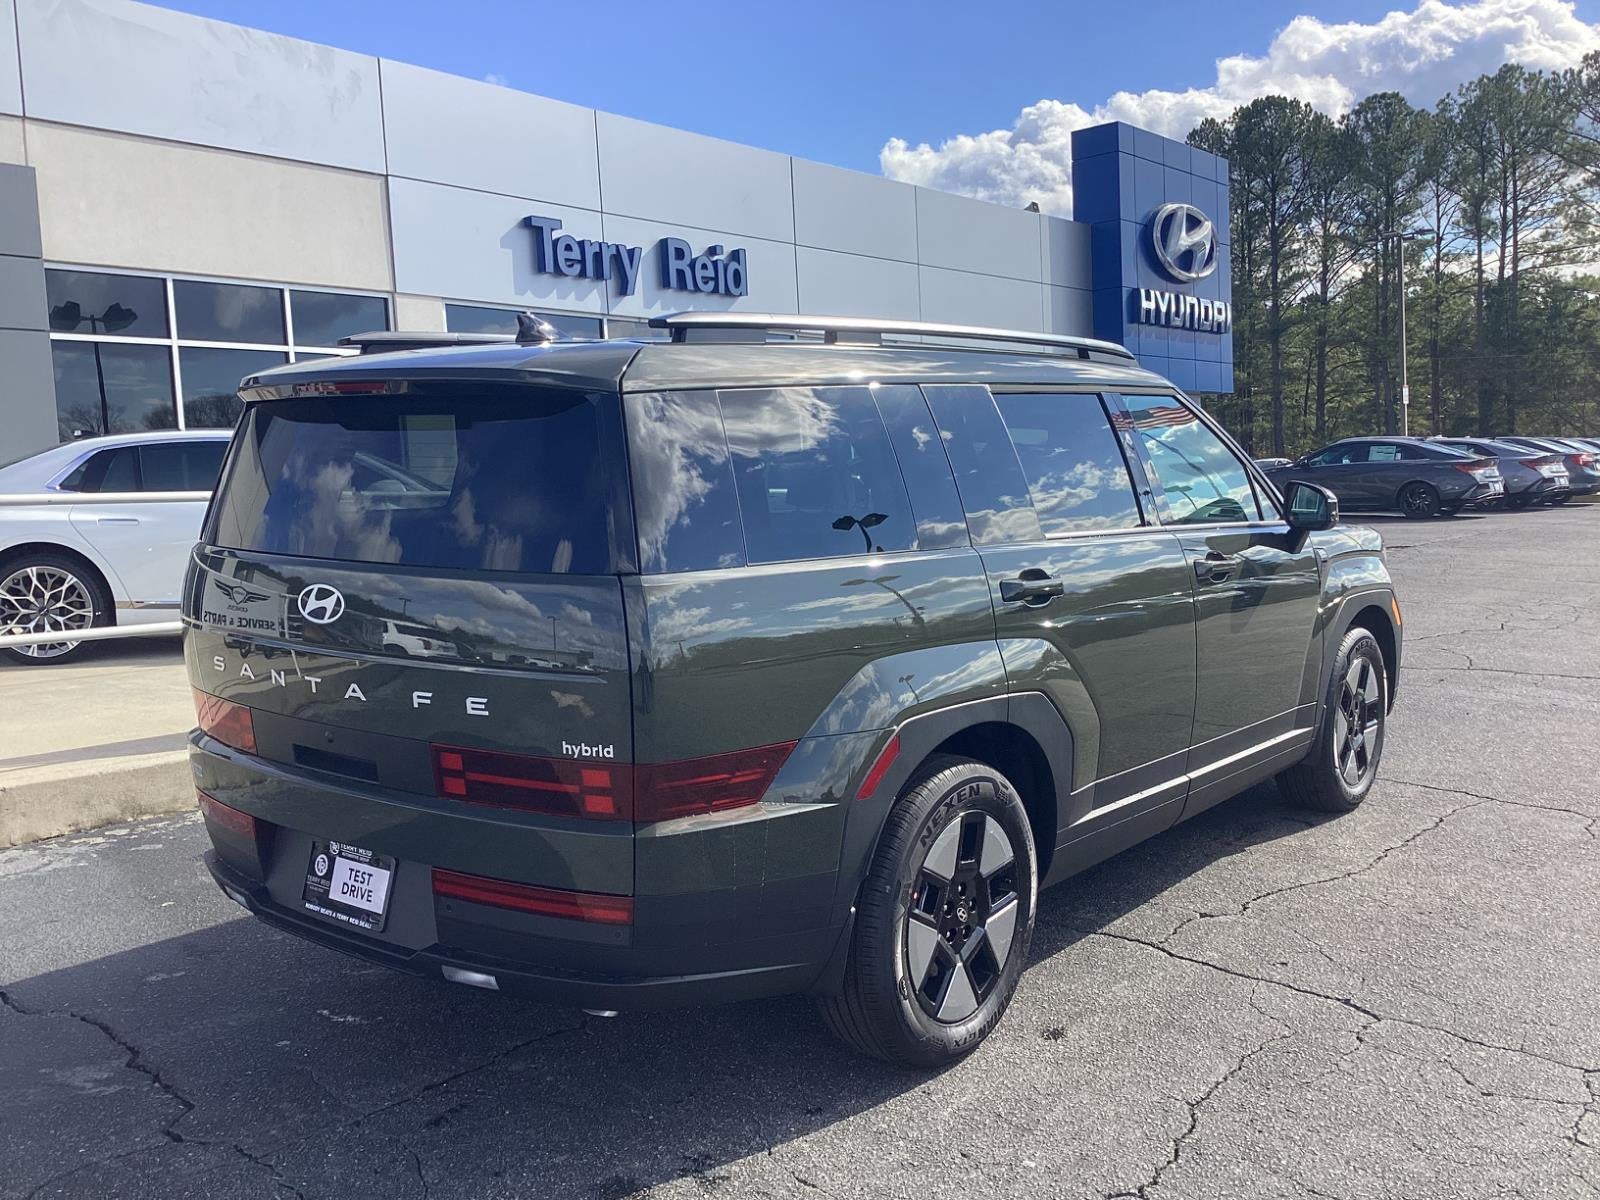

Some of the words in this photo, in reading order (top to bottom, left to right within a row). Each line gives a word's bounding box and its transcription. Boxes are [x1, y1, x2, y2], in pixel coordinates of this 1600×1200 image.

[523, 215, 642, 296] Terry
[659, 237, 748, 297] Reid
[1137, 288, 1232, 334] HYUNDAI
[213, 655, 367, 702] SANTA
[412, 691, 489, 716] FE
[562, 740, 614, 759] hybrid
[920, 783, 980, 849] NEXEN
[341, 882, 374, 903] DRIVE
[348, 867, 374, 886] TEST
